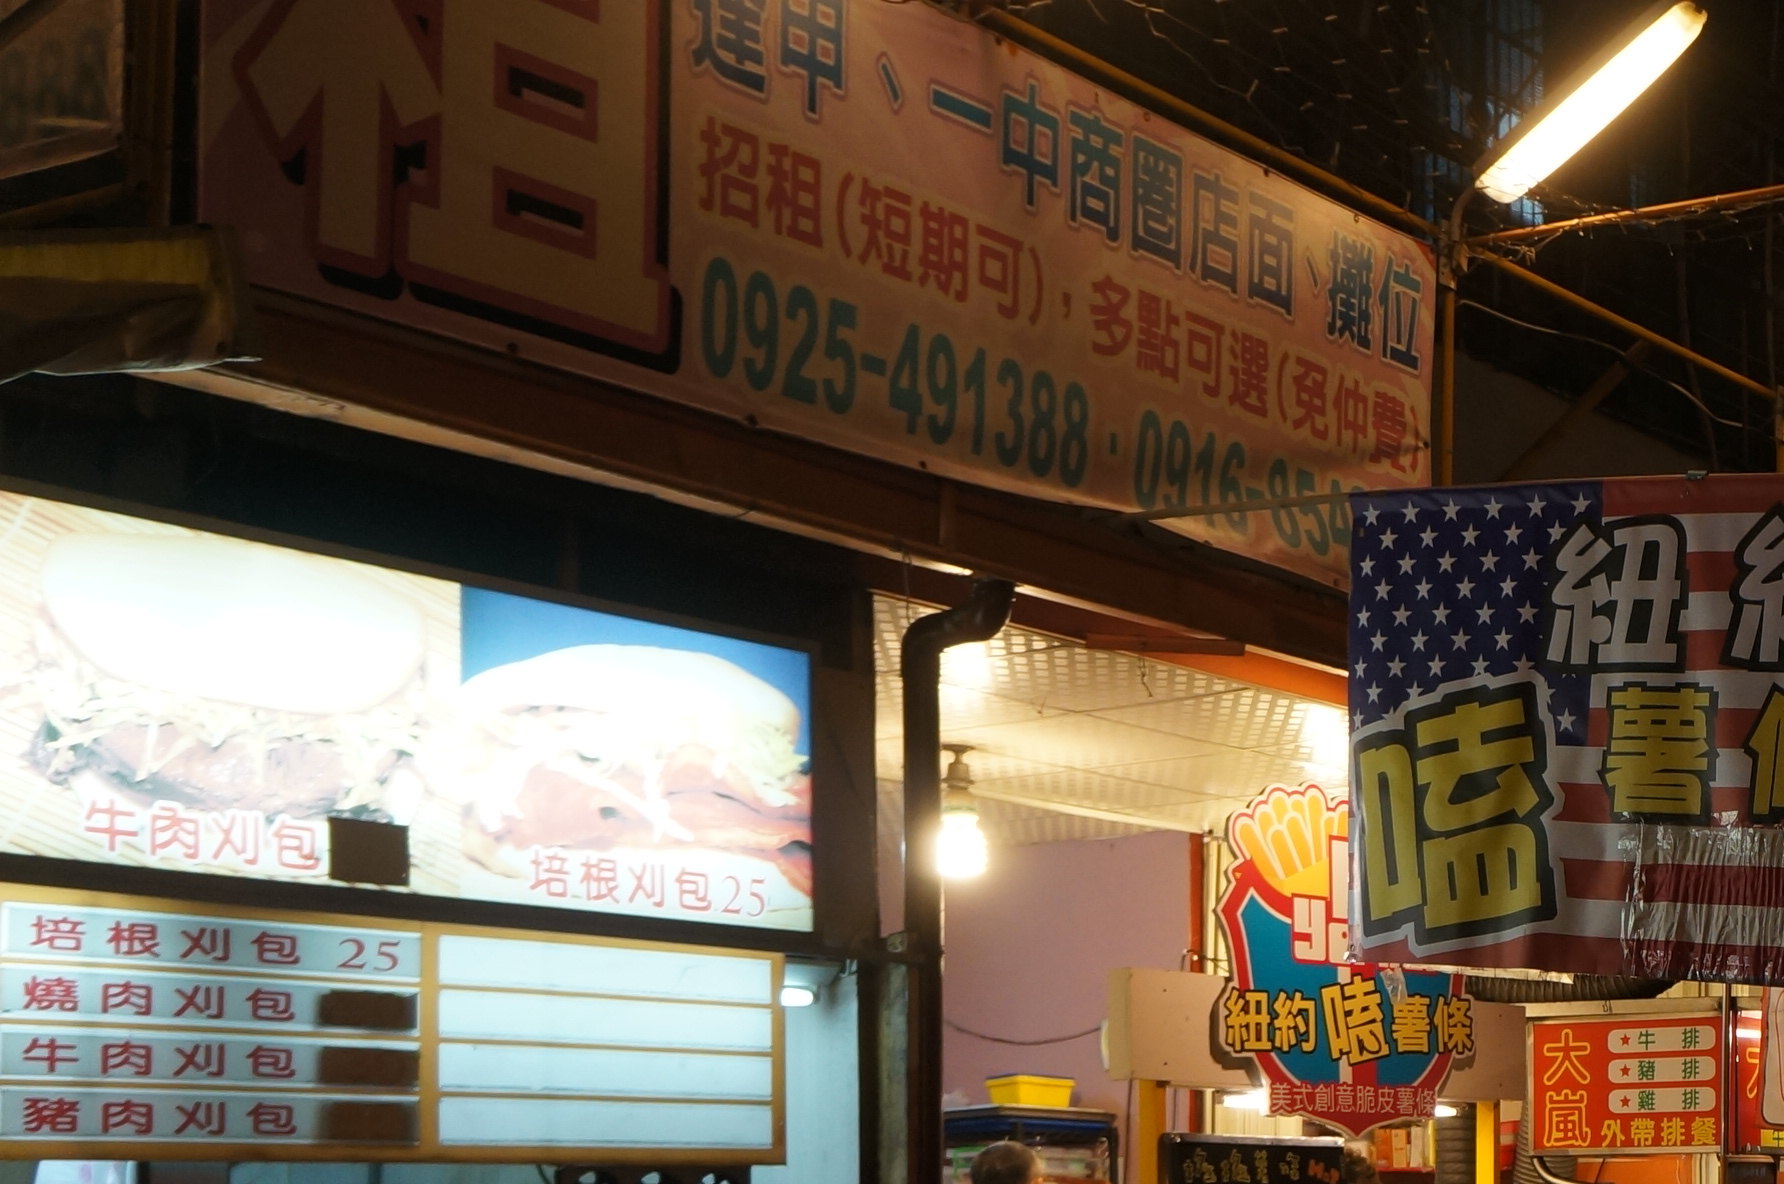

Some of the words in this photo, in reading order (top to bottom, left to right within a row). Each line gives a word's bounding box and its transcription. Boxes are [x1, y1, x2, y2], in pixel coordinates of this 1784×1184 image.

[701, 256, 1091, 489] 0925-491388
[83, 800, 321, 872] 牛肉刈包
[1358, 697, 1541, 930] 嗑
[529, 847, 712, 912] 培根刈包
[719, 874, 768, 919] 25
[29, 915, 301, 967] 培根刈包
[335, 938, 402, 974] 25
[23, 976, 297, 1022] 燒肉刈包
[1223, 972, 1475, 1067] 紐約嗑薯條
[22, 1035, 297, 1080] 牛肉刈包
[1637, 1027, 1700, 1051] 牛排
[21, 1096, 298, 1139] 豬肉刈包
[1268, 1081, 1438, 1117] 美式創意脆皮薯條
[1600, 1116, 1717, 1148] 外帶排餐
